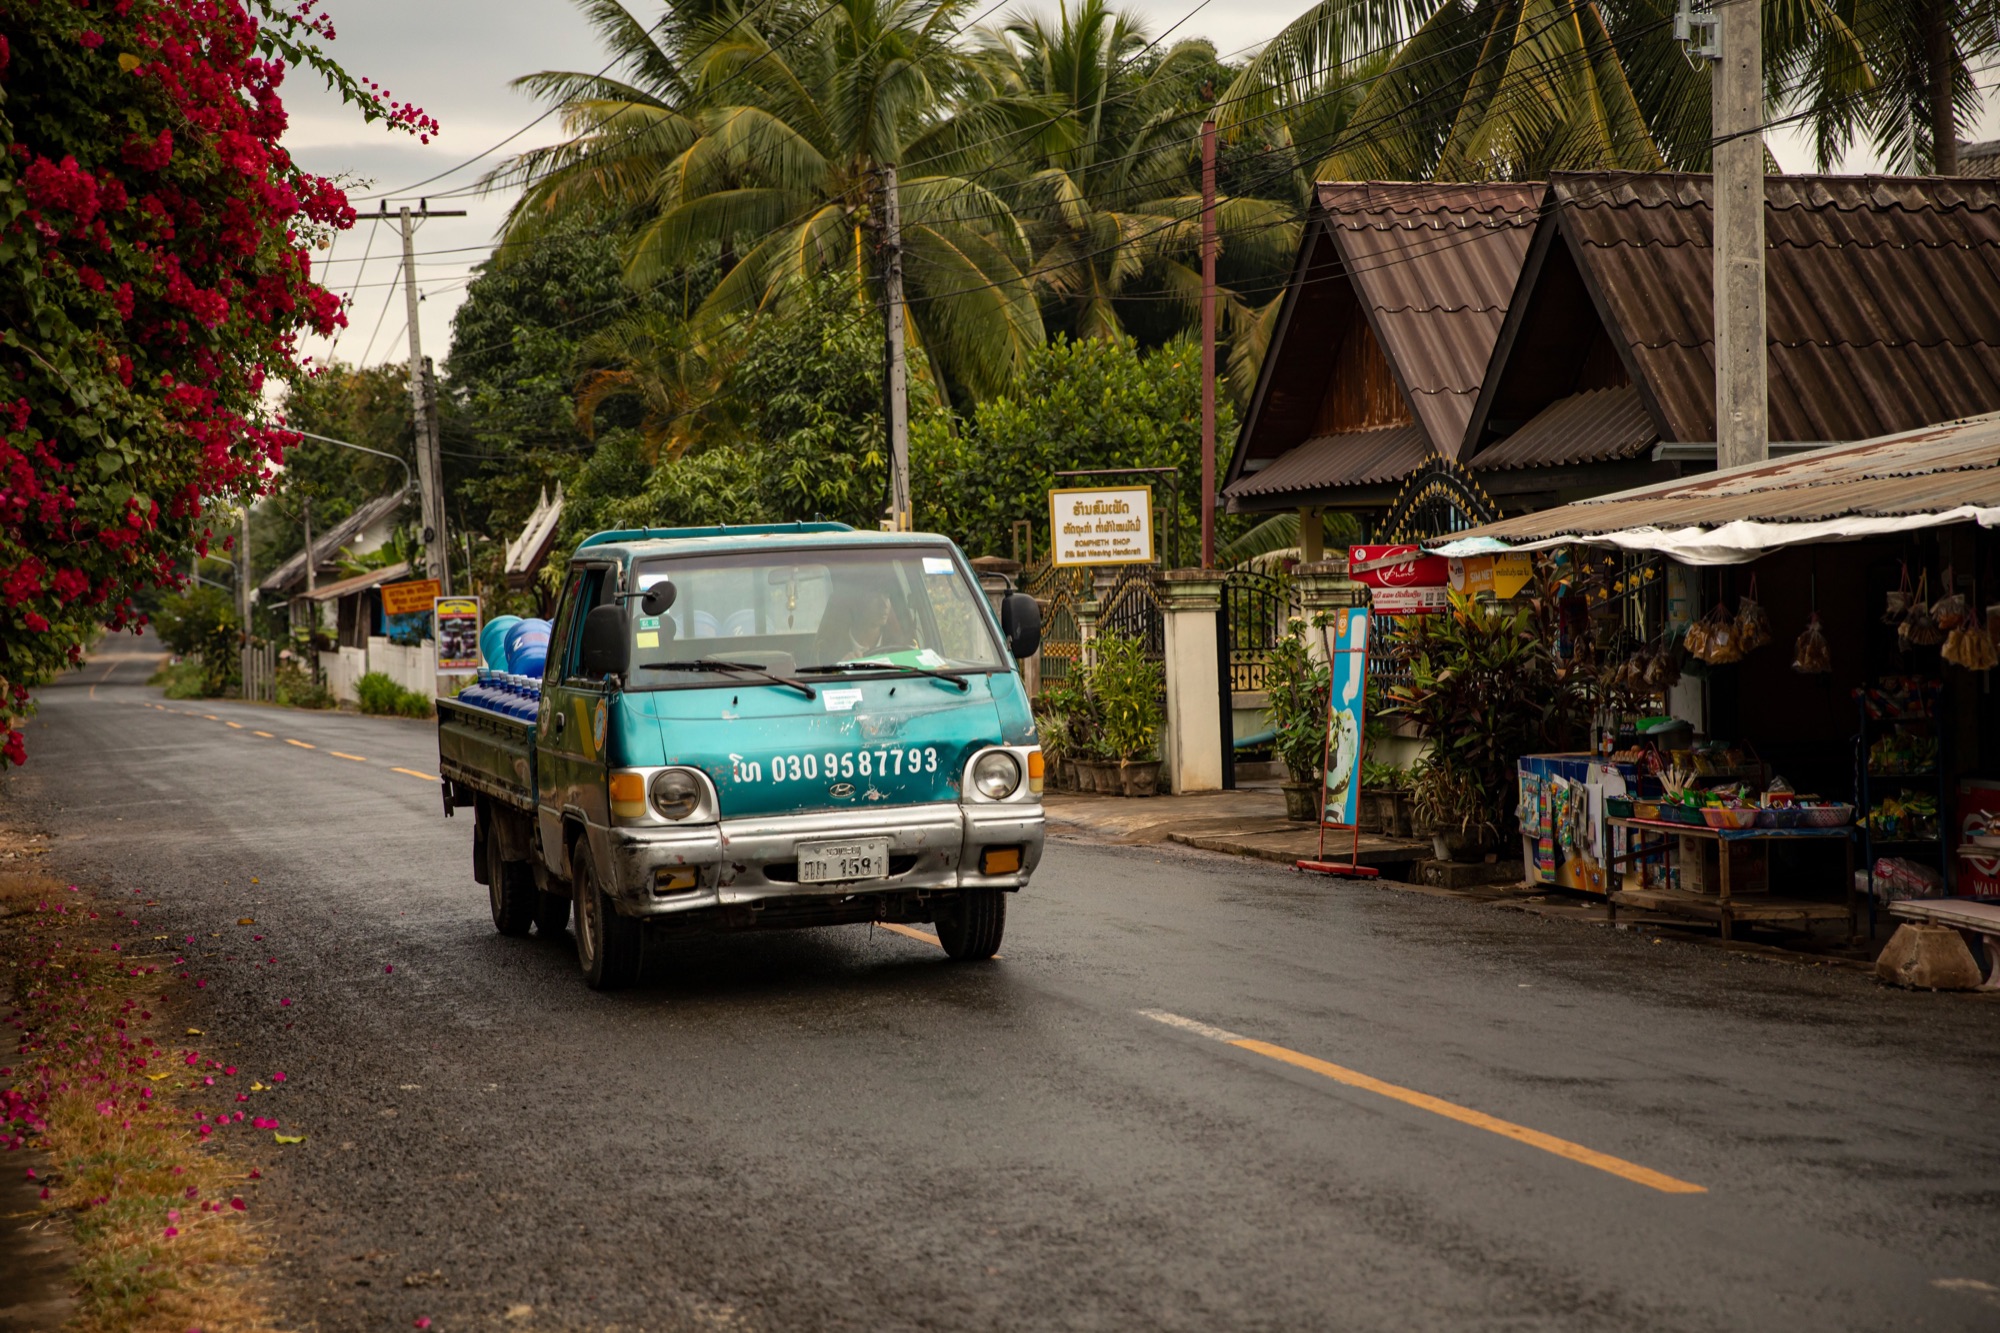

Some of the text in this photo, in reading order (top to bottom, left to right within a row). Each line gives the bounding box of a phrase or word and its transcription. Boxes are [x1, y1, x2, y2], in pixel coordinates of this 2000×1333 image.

[1074, 538, 1131, 548] SOMPHETH SHOP
[1087, 549, 1111, 558] Weaving
[771, 754, 818, 782] 030
[824, 747, 938, 778] 9587793
[838, 856, 883, 878] 1581
